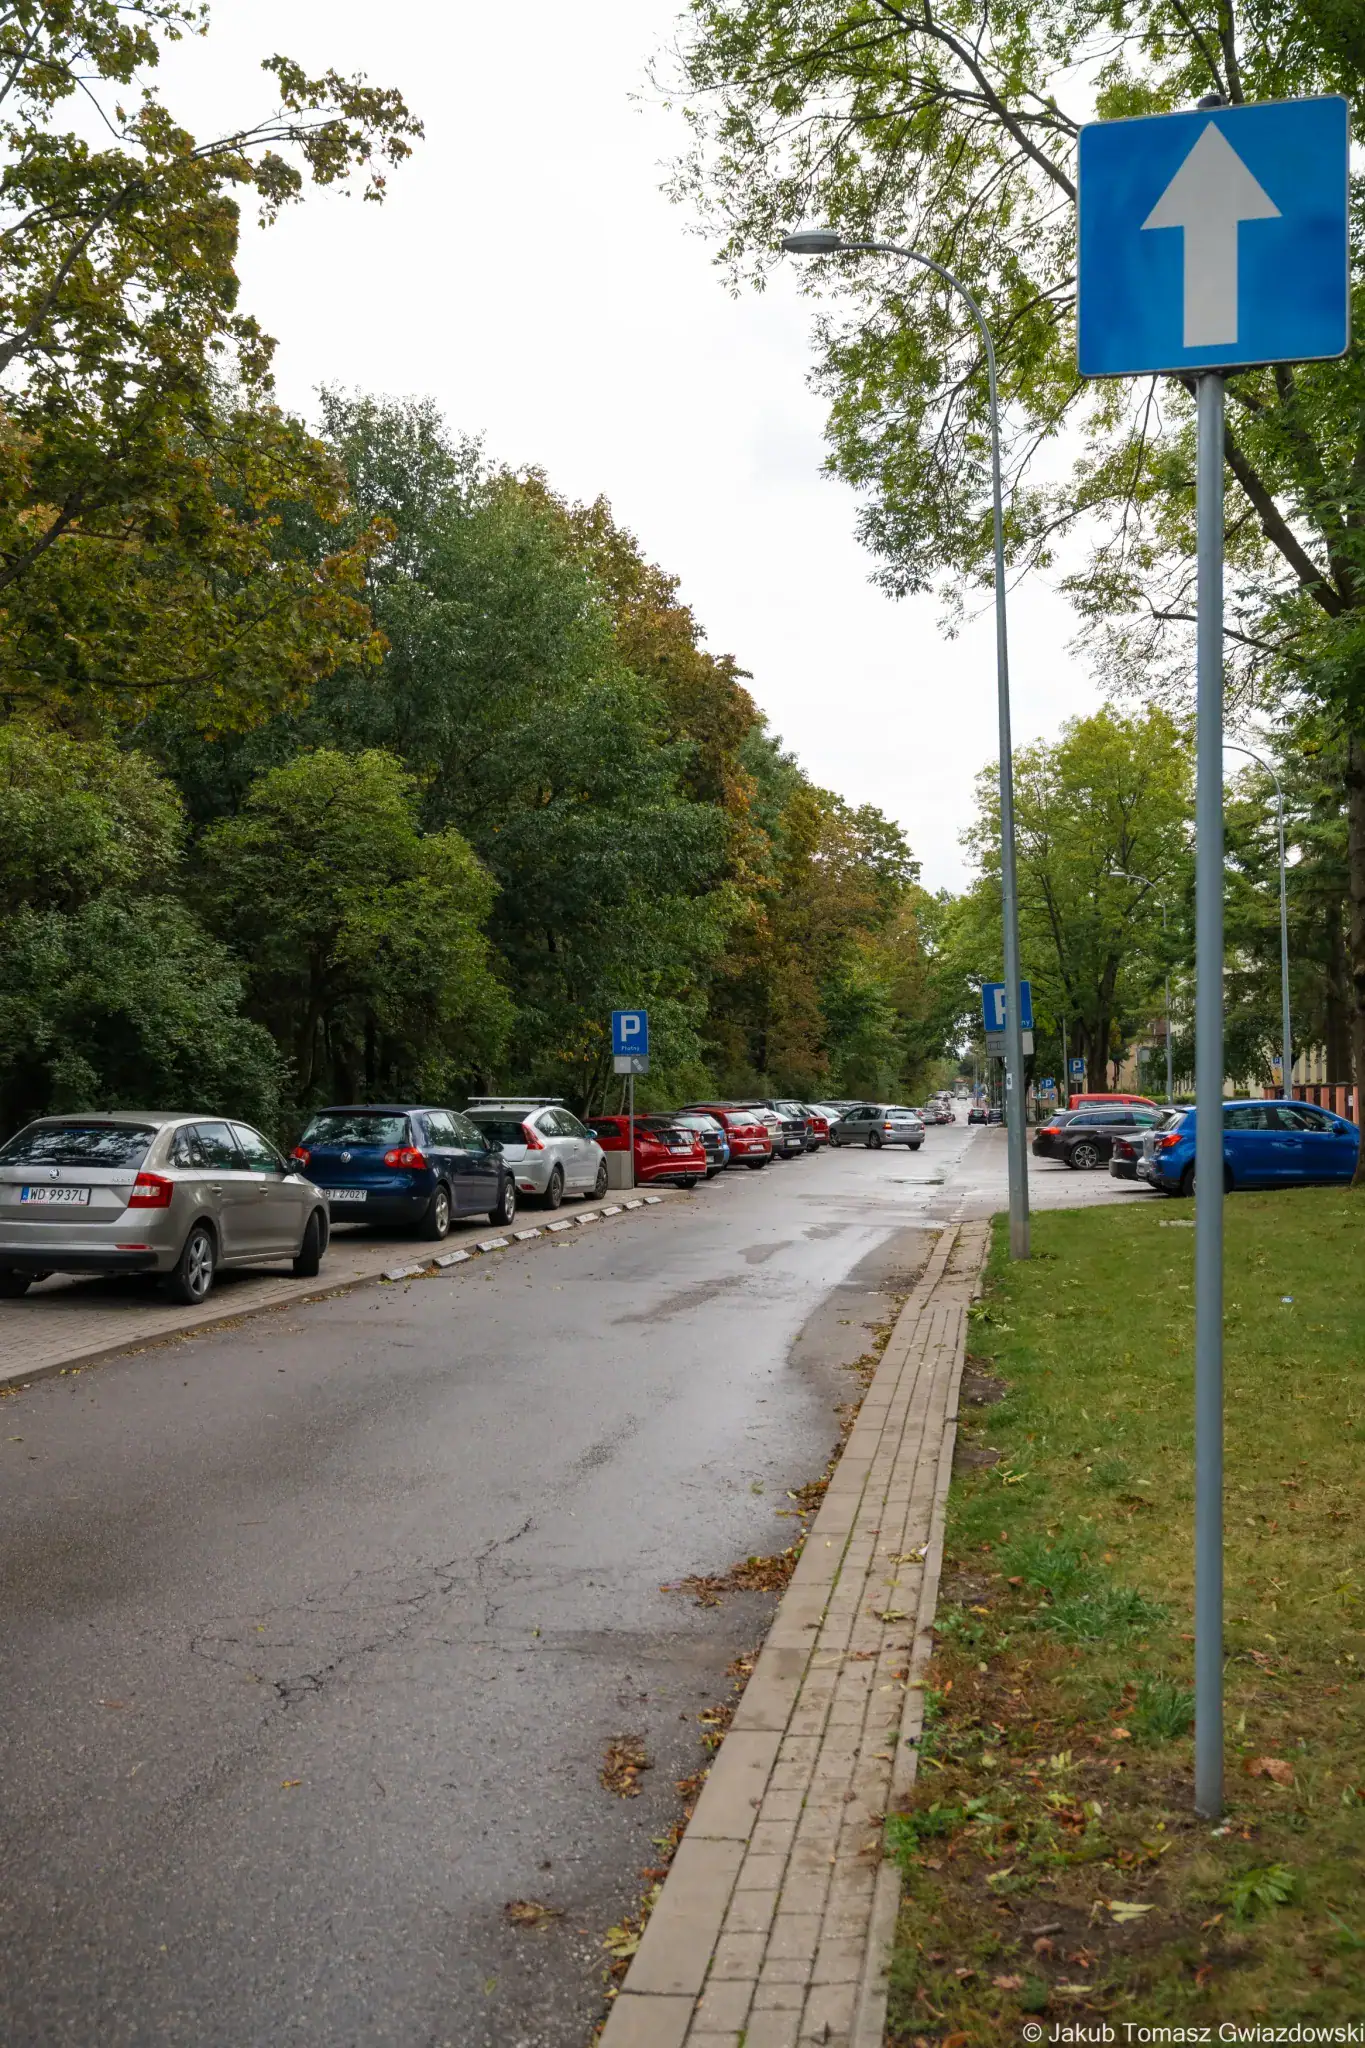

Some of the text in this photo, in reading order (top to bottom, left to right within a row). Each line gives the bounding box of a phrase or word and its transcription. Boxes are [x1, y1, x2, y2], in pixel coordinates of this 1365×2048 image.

[620, 1015, 641, 1042] P
[1072, 1060, 1081, 1071] P
[1045, 1079, 1052, 1087] P
[30, 1188, 46, 1200] WD
[49, 1189, 86, 1202] 9937L
